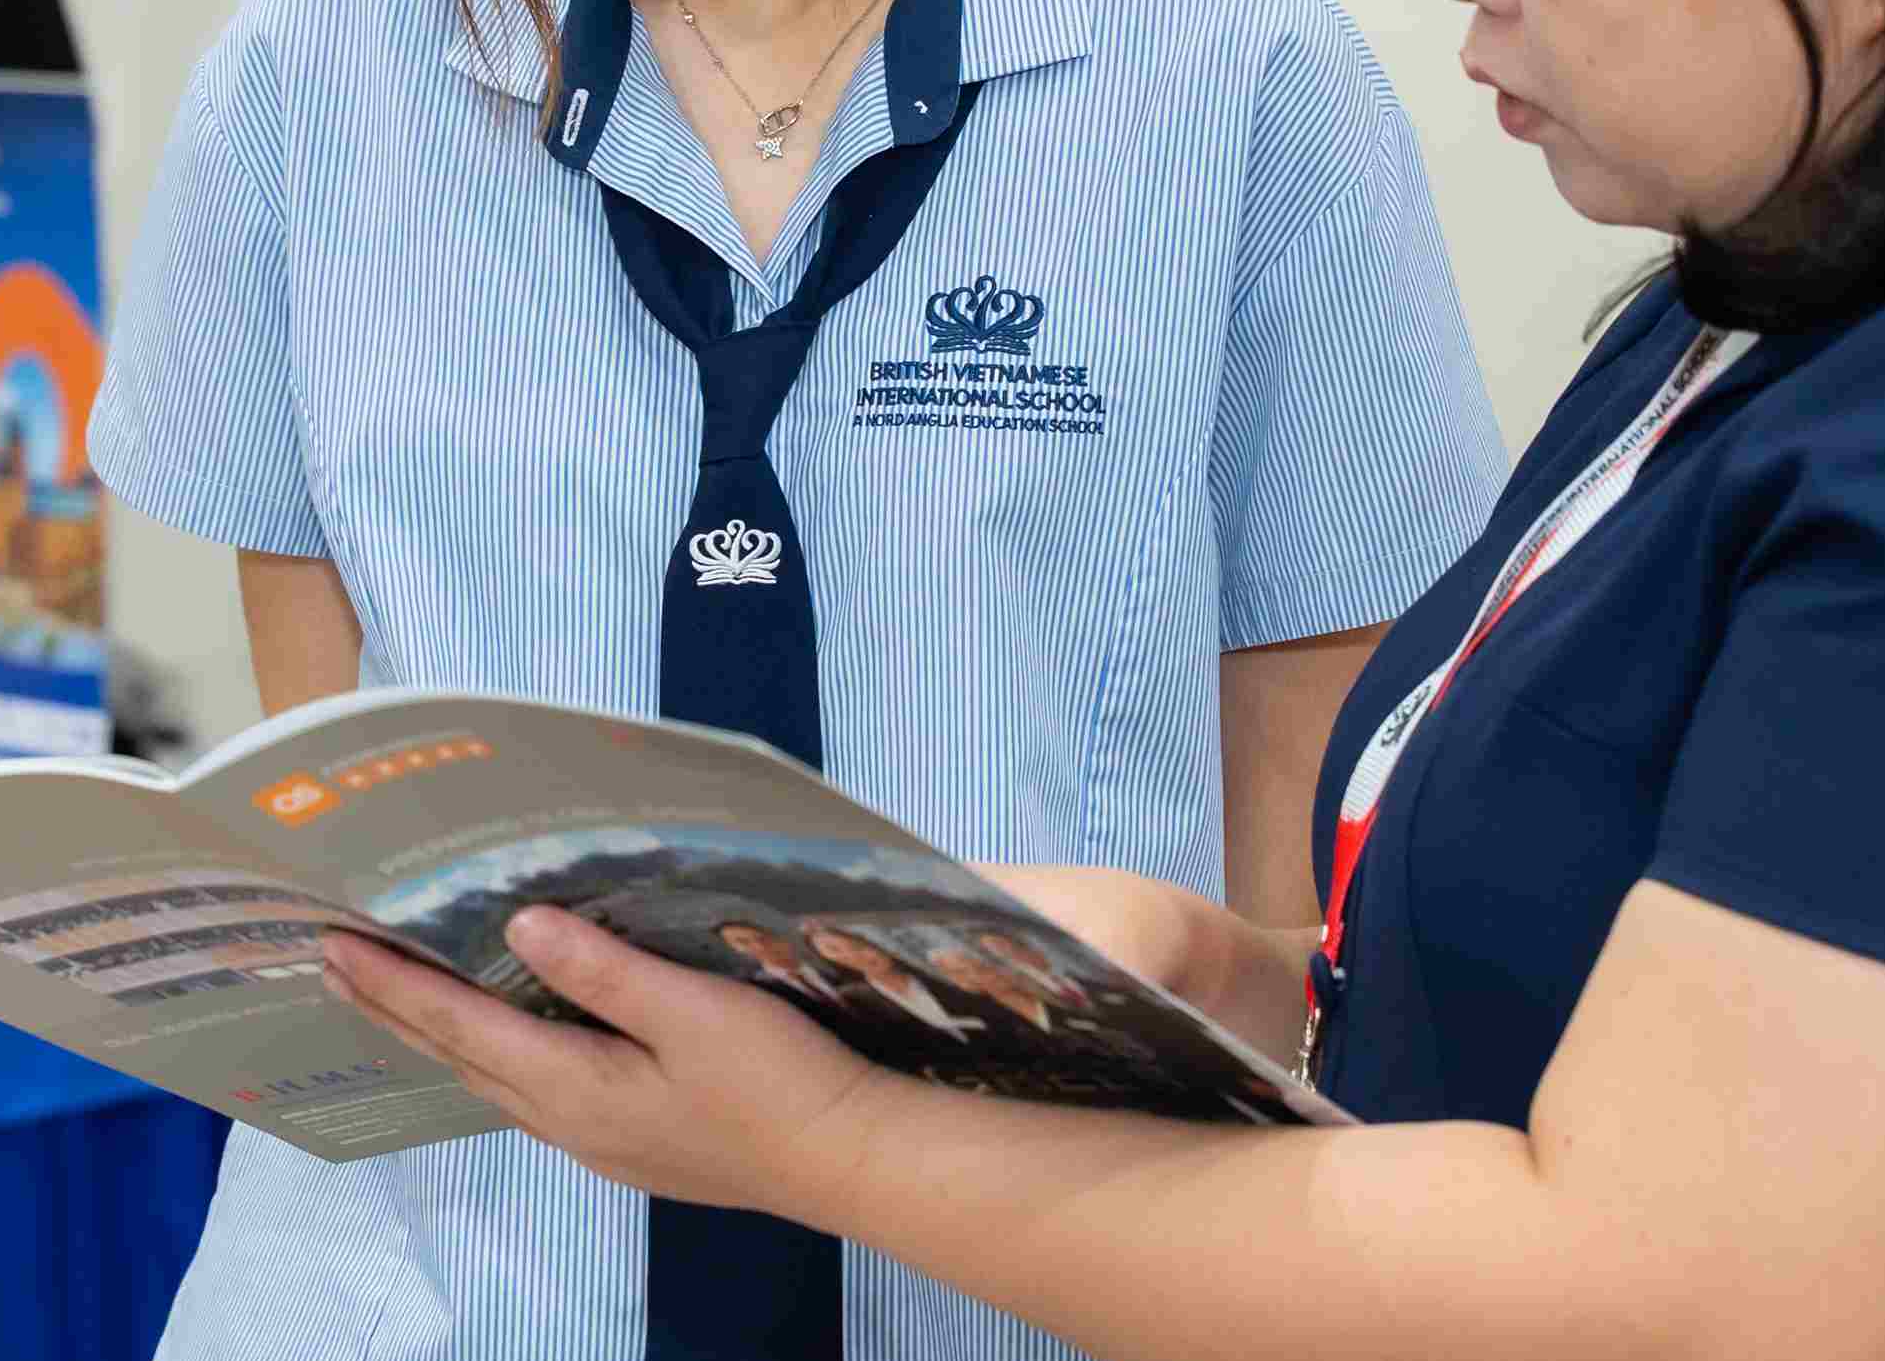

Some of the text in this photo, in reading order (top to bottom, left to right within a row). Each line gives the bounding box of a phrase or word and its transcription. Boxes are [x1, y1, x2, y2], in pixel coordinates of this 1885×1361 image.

[870, 361, 1088, 387] BRITISH VIETNAMESE
[856, 387, 1106, 414] INTERNATIONAL SCHOOL
[853, 413, 1106, 435] A NORD ANGLIA EDUCATION SCHOOL
